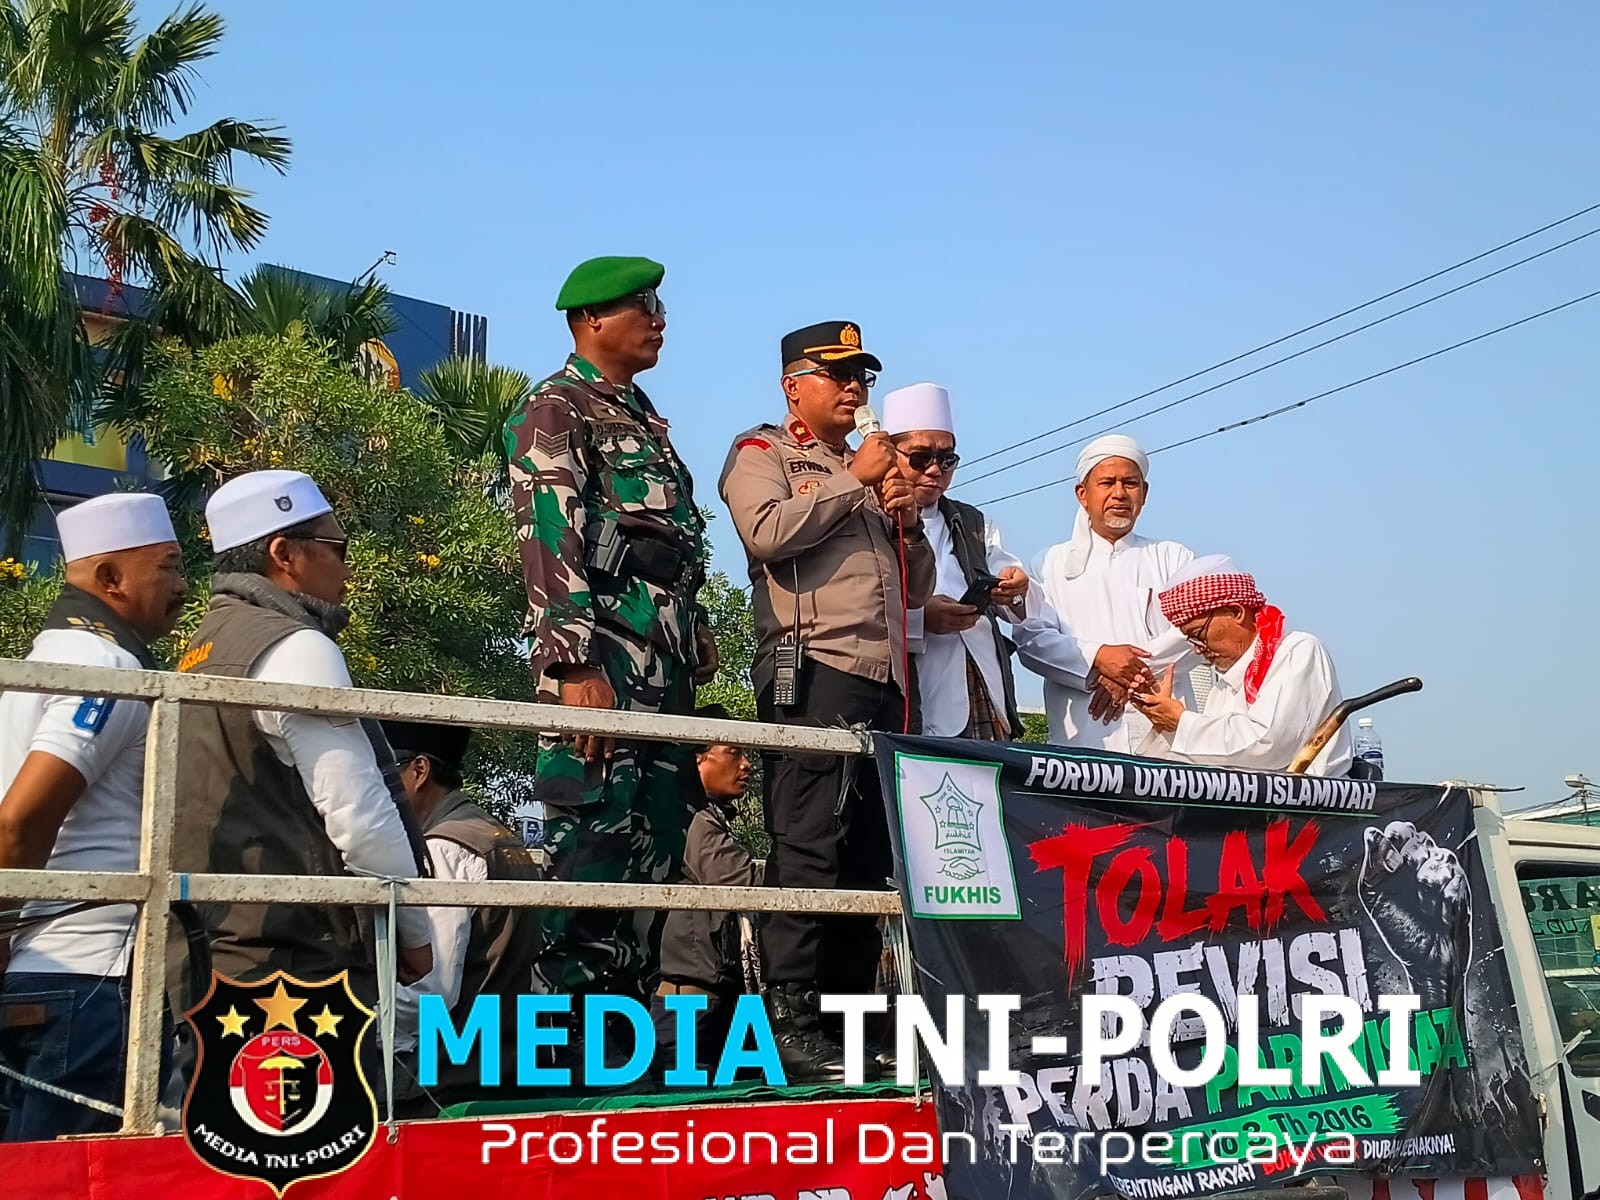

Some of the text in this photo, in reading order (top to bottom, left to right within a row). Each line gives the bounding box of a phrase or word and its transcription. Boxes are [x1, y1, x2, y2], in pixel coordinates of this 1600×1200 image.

[1024, 756, 1377, 810] FORUM UKHUWAH ISLAMIYAH
[924, 885, 1002, 904] FUKHIS
[1026, 818, 1329, 990] TOLAK
[1088, 927, 1374, 1050] REVISI
[1242, 1121, 1263, 1147] 3
[1268, 1112, 1303, 1138] Th
[1308, 1104, 1374, 1134] 2016
[1195, 1160, 1256, 1192] RAKYAT
